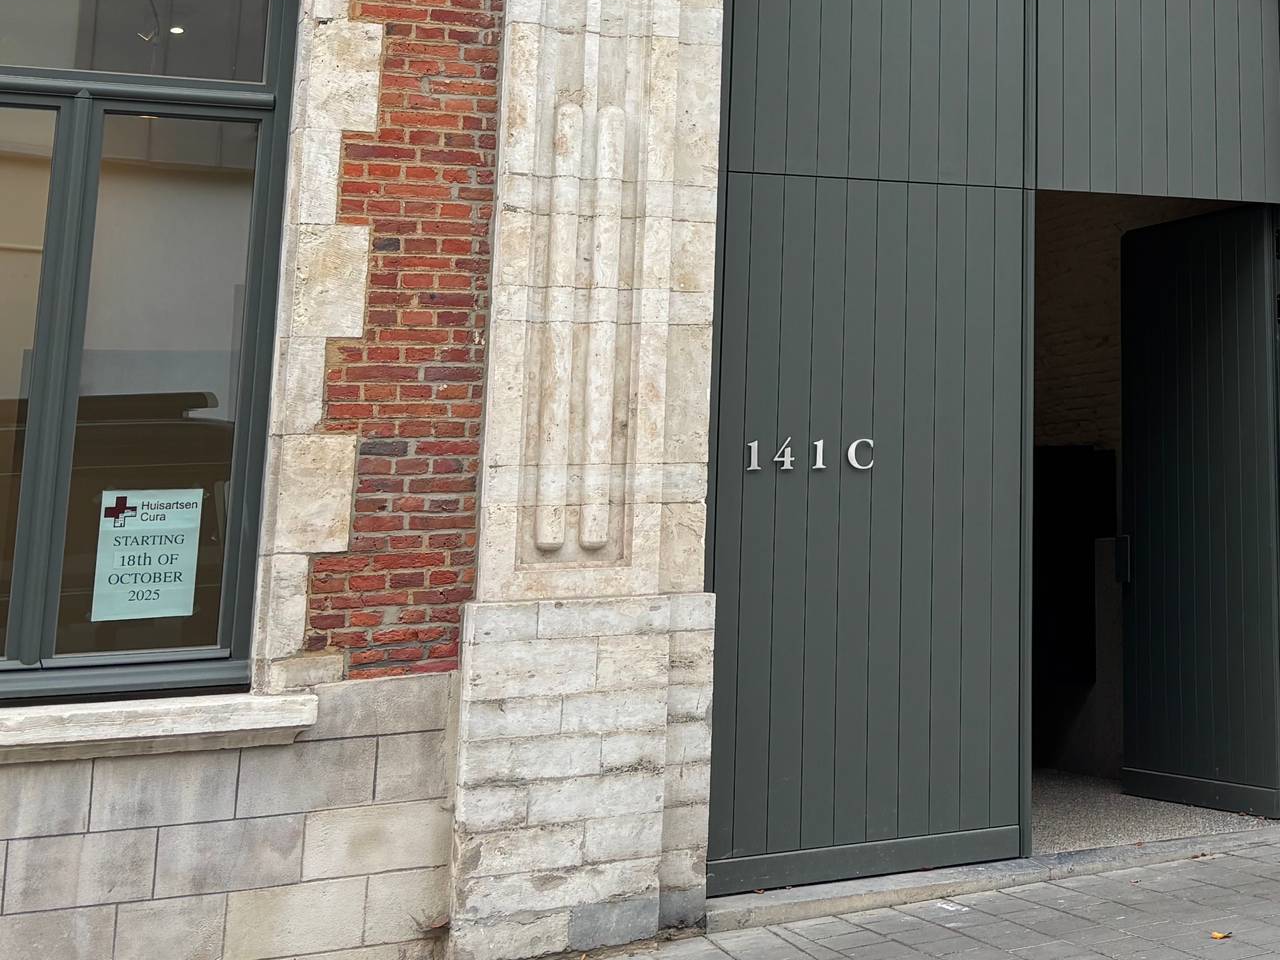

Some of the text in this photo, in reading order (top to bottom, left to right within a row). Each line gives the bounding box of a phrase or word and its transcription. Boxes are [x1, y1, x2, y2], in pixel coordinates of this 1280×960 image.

[141, 500, 198, 511] Huisartsen
[140, 512, 166, 522] Cura
[113, 534, 185, 547] STARTING
[120, 552, 180, 567] 18th OF
[108, 571, 183, 585] OCTOBER
[128, 589, 160, 601] 2025
